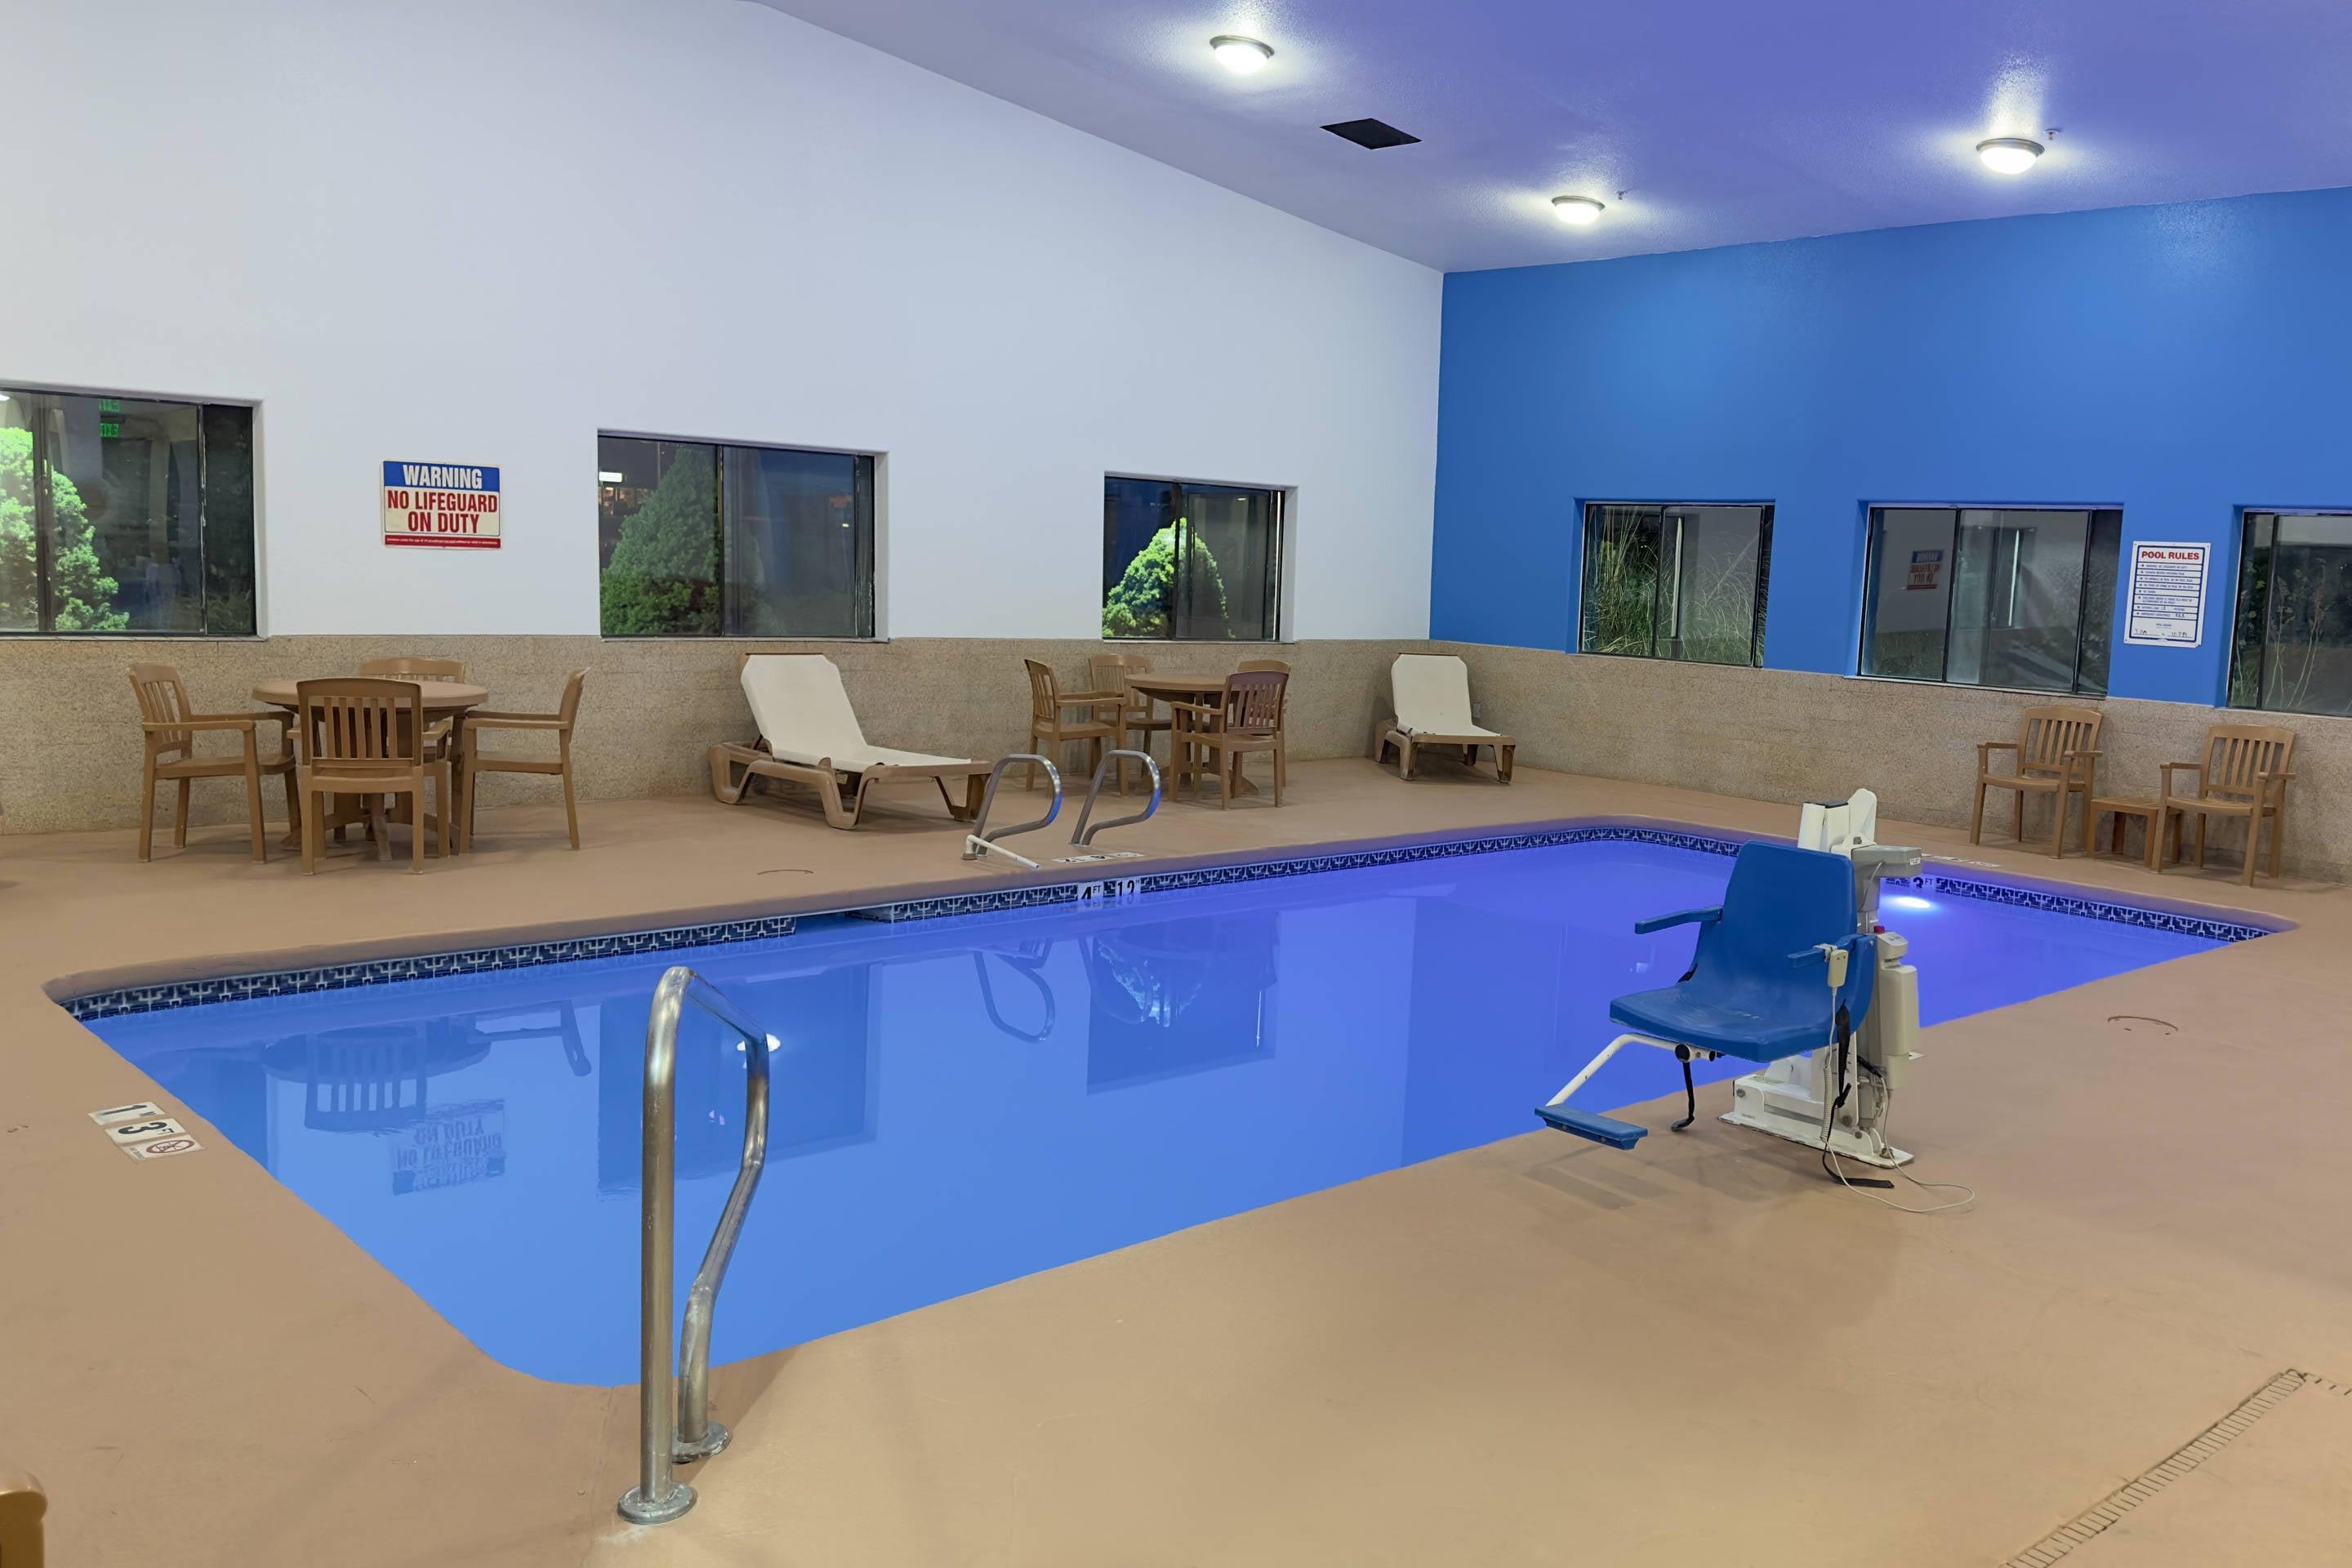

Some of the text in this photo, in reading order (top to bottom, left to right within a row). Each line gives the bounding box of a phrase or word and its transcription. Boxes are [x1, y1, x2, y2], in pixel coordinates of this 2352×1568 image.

[403, 465, 483, 489] WARNING
[387, 490, 497, 513] NO LIFEGUARD
[408, 511, 479, 533] ON DUTY
[2141, 551, 2200, 560] POOL RULES
[1093, 885, 1101, 893] FT
[118, 1121, 167, 1134] 3
